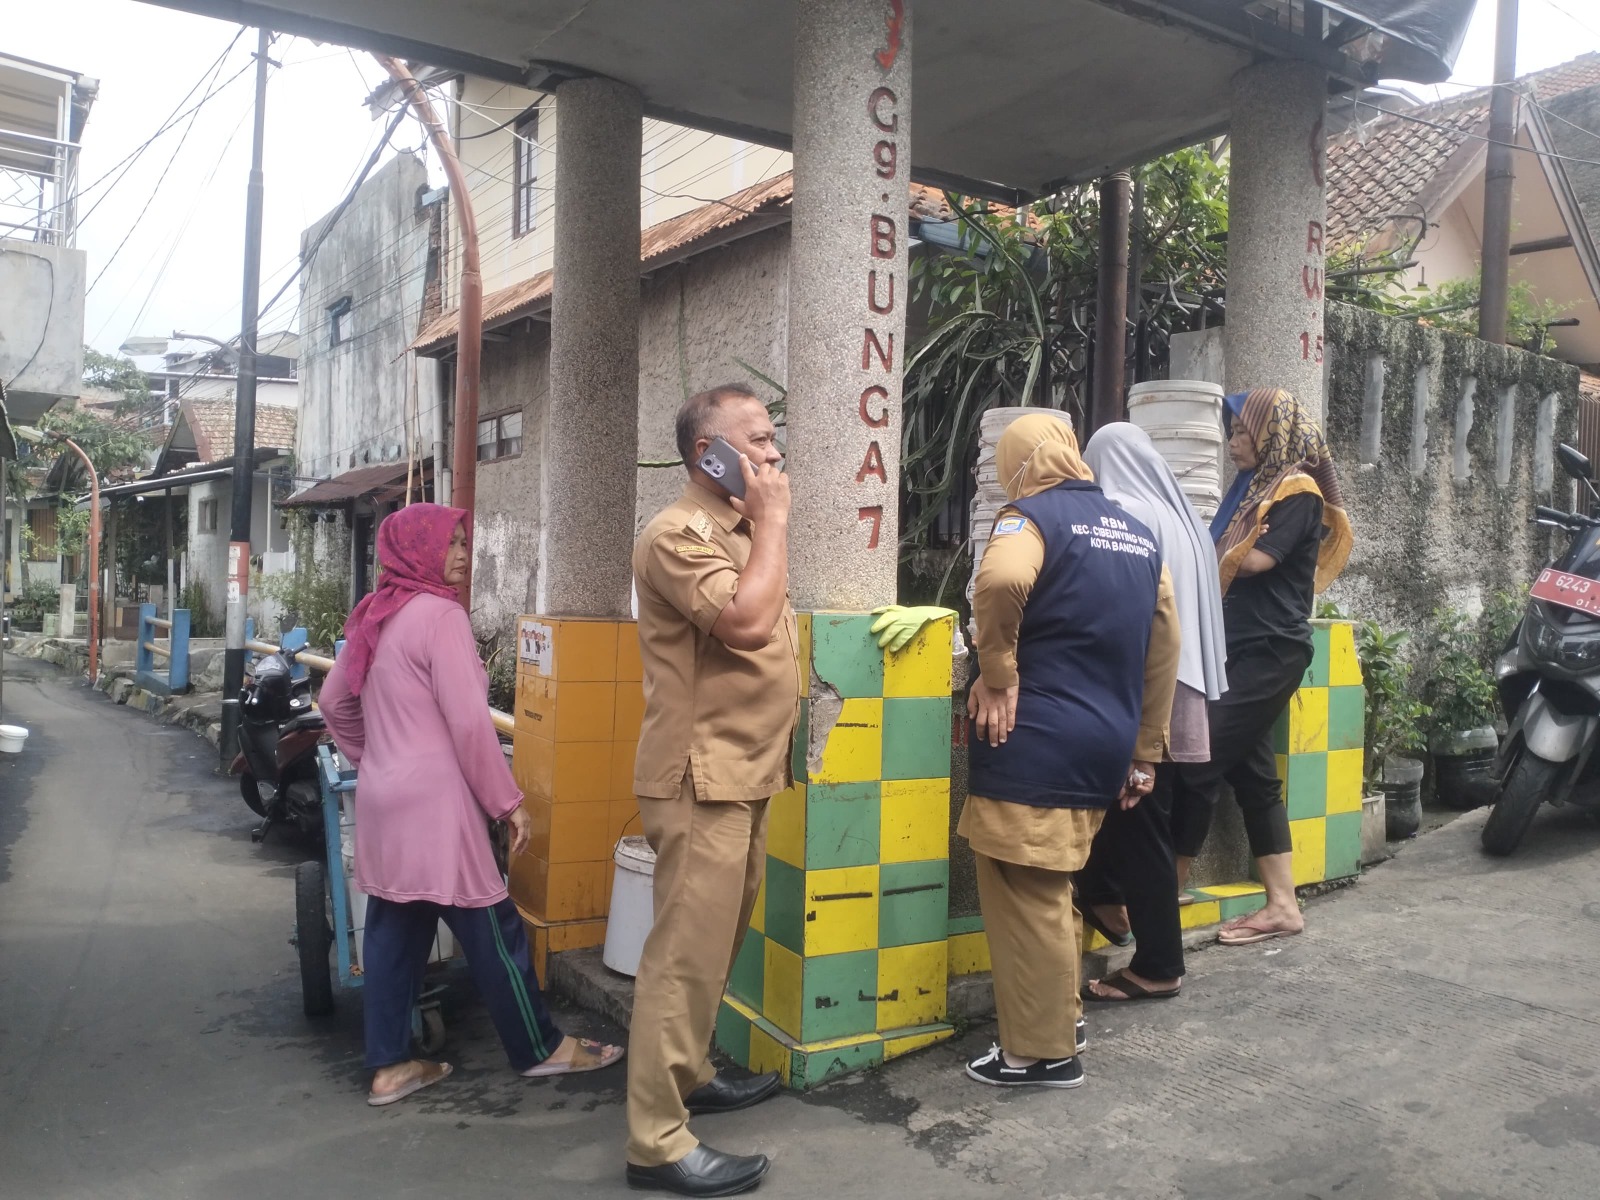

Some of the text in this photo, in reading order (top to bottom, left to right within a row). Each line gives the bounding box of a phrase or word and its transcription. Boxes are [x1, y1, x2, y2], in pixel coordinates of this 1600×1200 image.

[855, 213, 897, 484] BUNGA
[858, 505, 884, 549] 7
[1071, 524, 1093, 535] KEC.
[1092, 526, 1138, 543] CIBEUNYING
[1100, 516, 1128, 531] RBM
[1090, 537, 1150, 558] KOTA BANDUNG
[1540, 571, 1591, 593] D 6243
